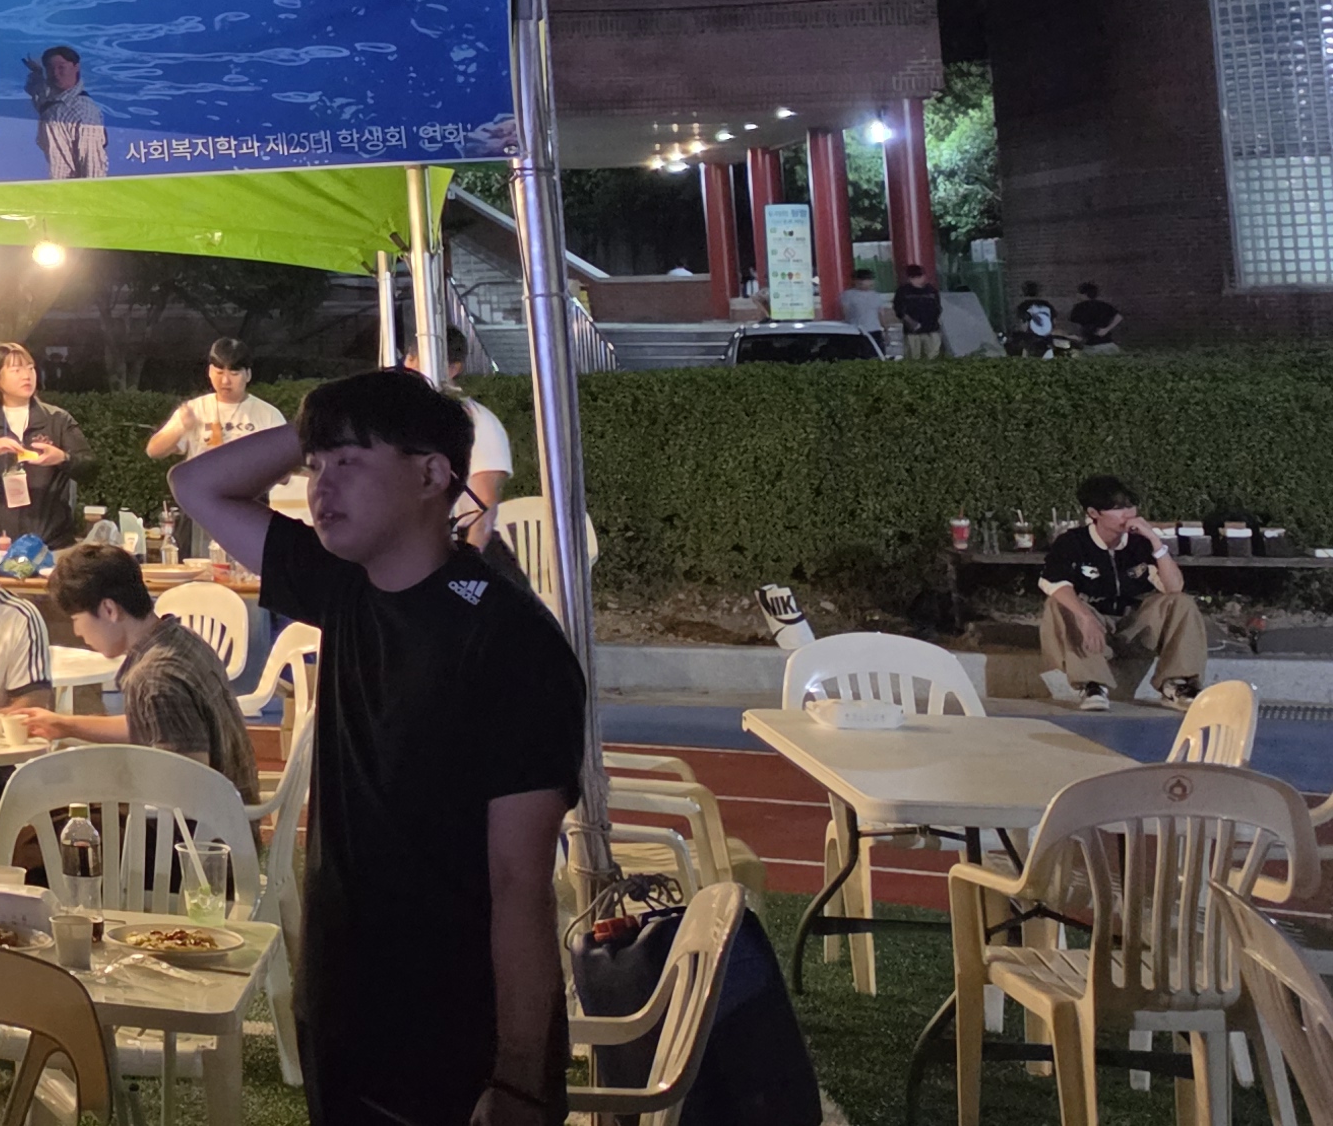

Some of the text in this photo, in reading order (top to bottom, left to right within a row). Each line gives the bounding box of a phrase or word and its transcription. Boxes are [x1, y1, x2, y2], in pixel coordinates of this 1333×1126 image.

[124, 121, 473, 165] 사회복지학과 제25대 학생회 '연화'
[769, 595, 799, 616] NIK
